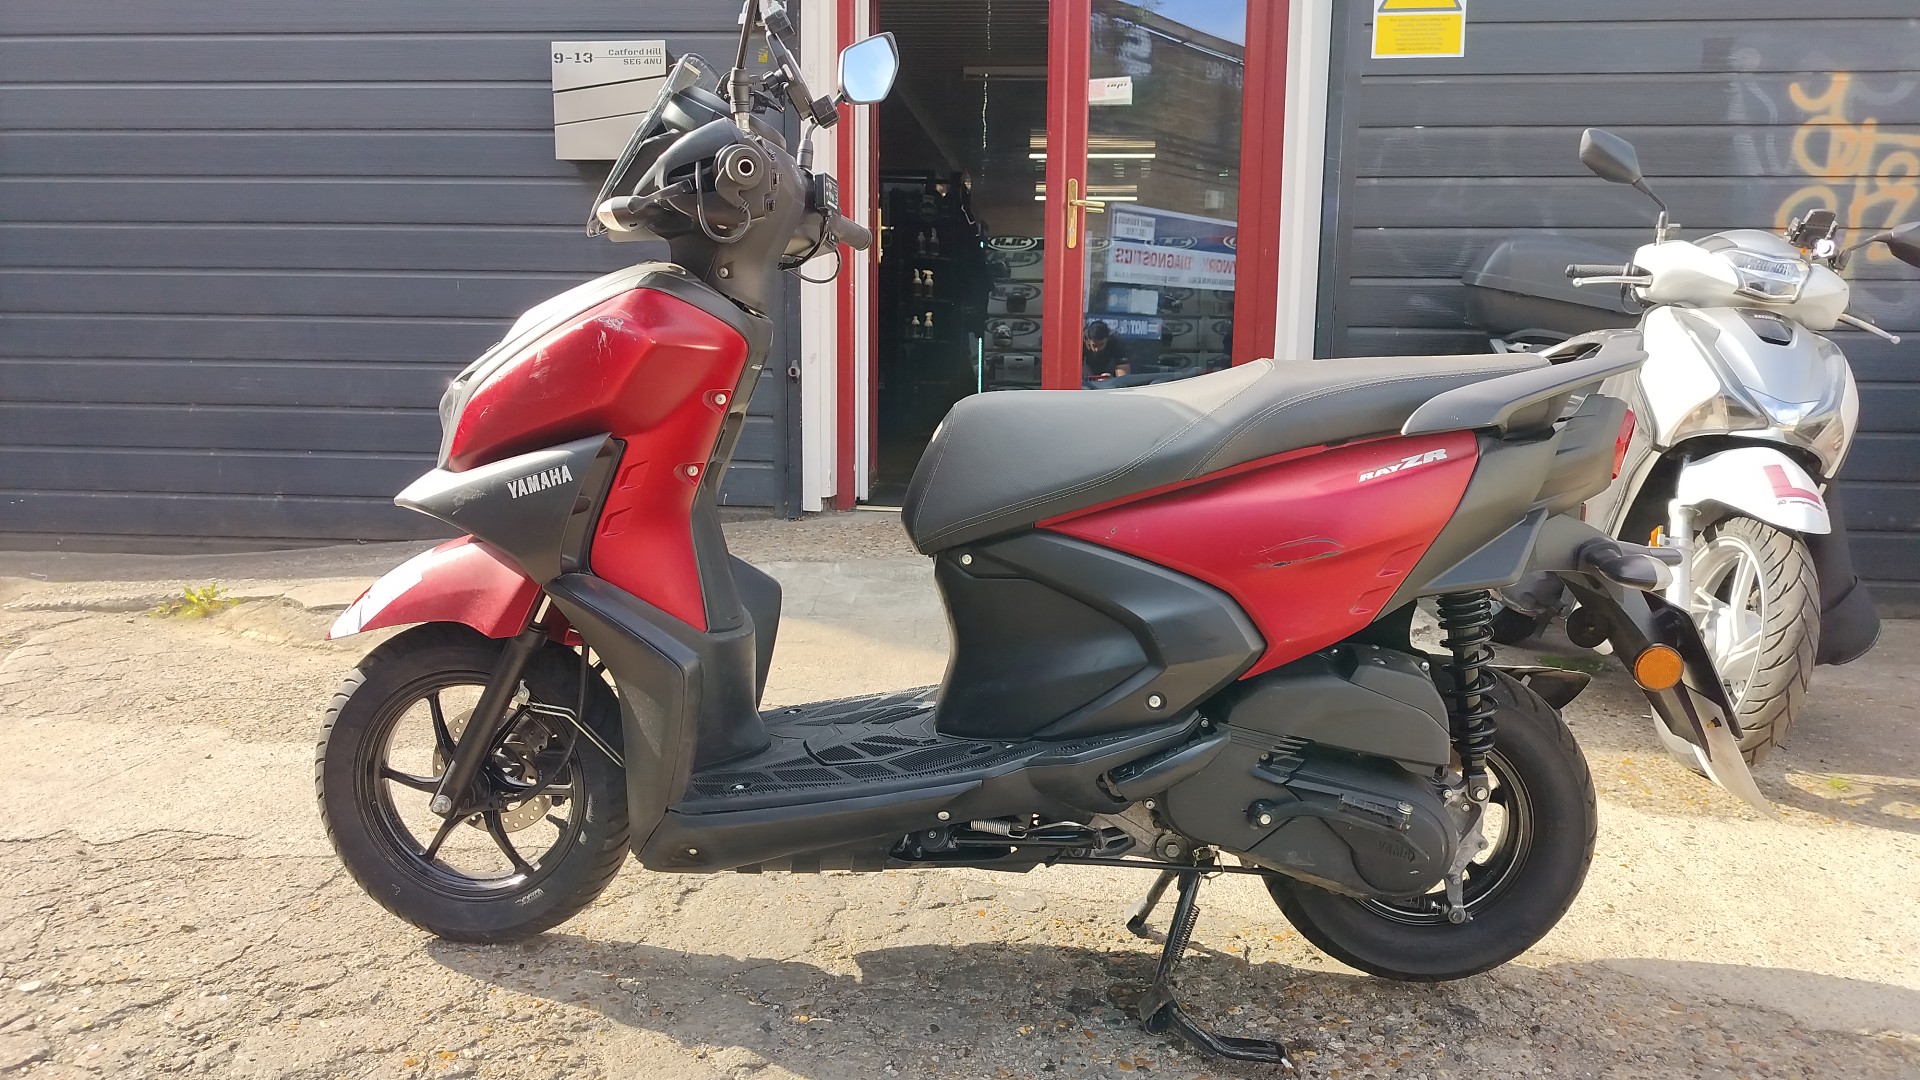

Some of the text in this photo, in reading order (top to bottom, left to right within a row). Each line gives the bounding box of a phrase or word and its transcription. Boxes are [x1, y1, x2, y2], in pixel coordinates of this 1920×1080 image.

[608, 48, 662, 56] Catford Hill
[553, 52, 593, 64] 9-13
[993, 238, 1029, 246] HJC
[506, 465, 573, 499] YAMAHA
